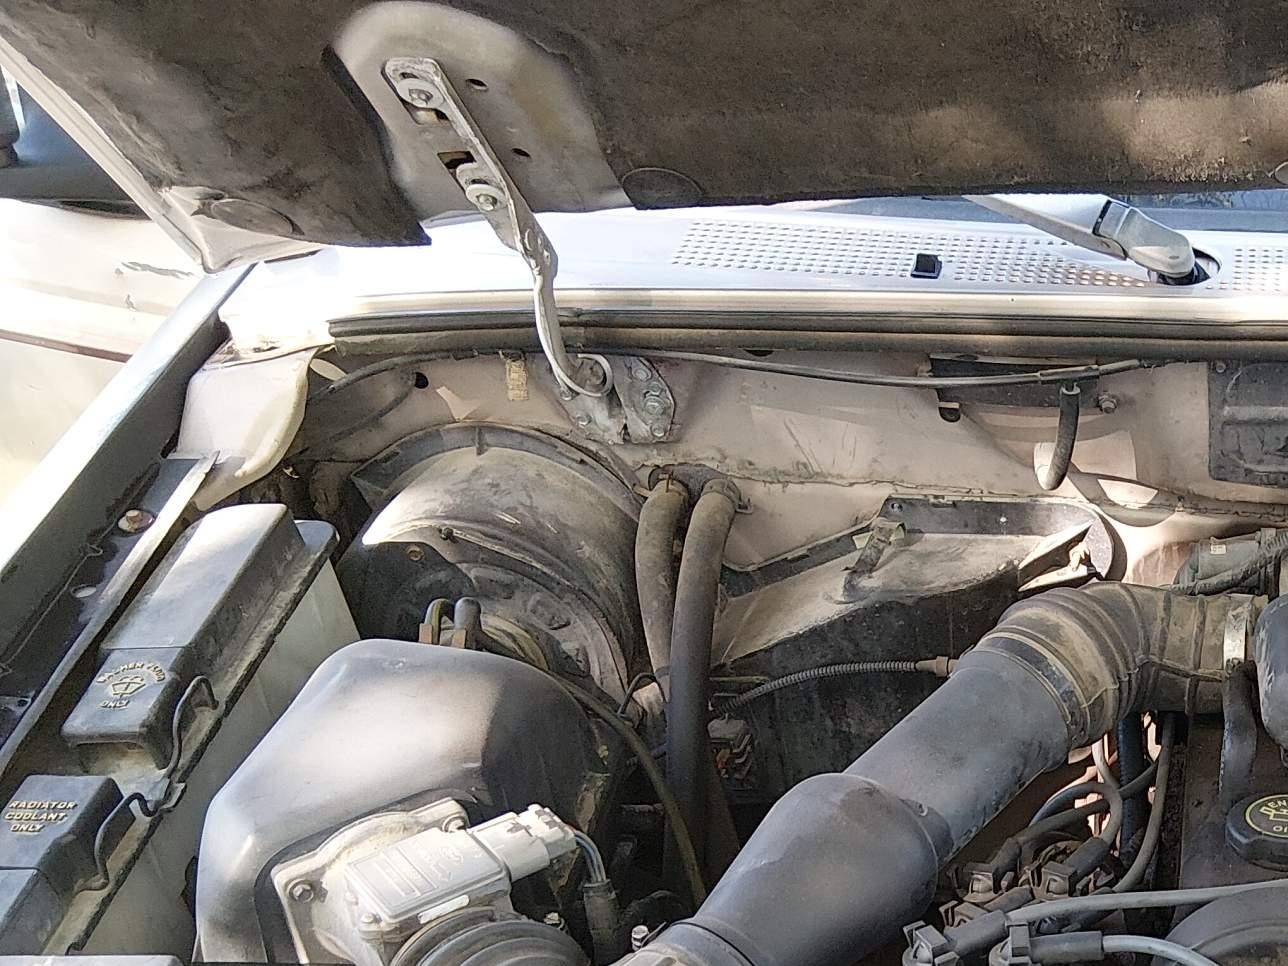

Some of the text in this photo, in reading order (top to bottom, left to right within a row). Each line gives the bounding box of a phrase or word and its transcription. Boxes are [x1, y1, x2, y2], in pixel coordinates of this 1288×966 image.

[99, 699, 130, 709] ONLY
[8, 801, 78, 810] RADIATOR
[4, 811, 68, 822] COOLANT
[10, 823, 46, 833] ONLY
